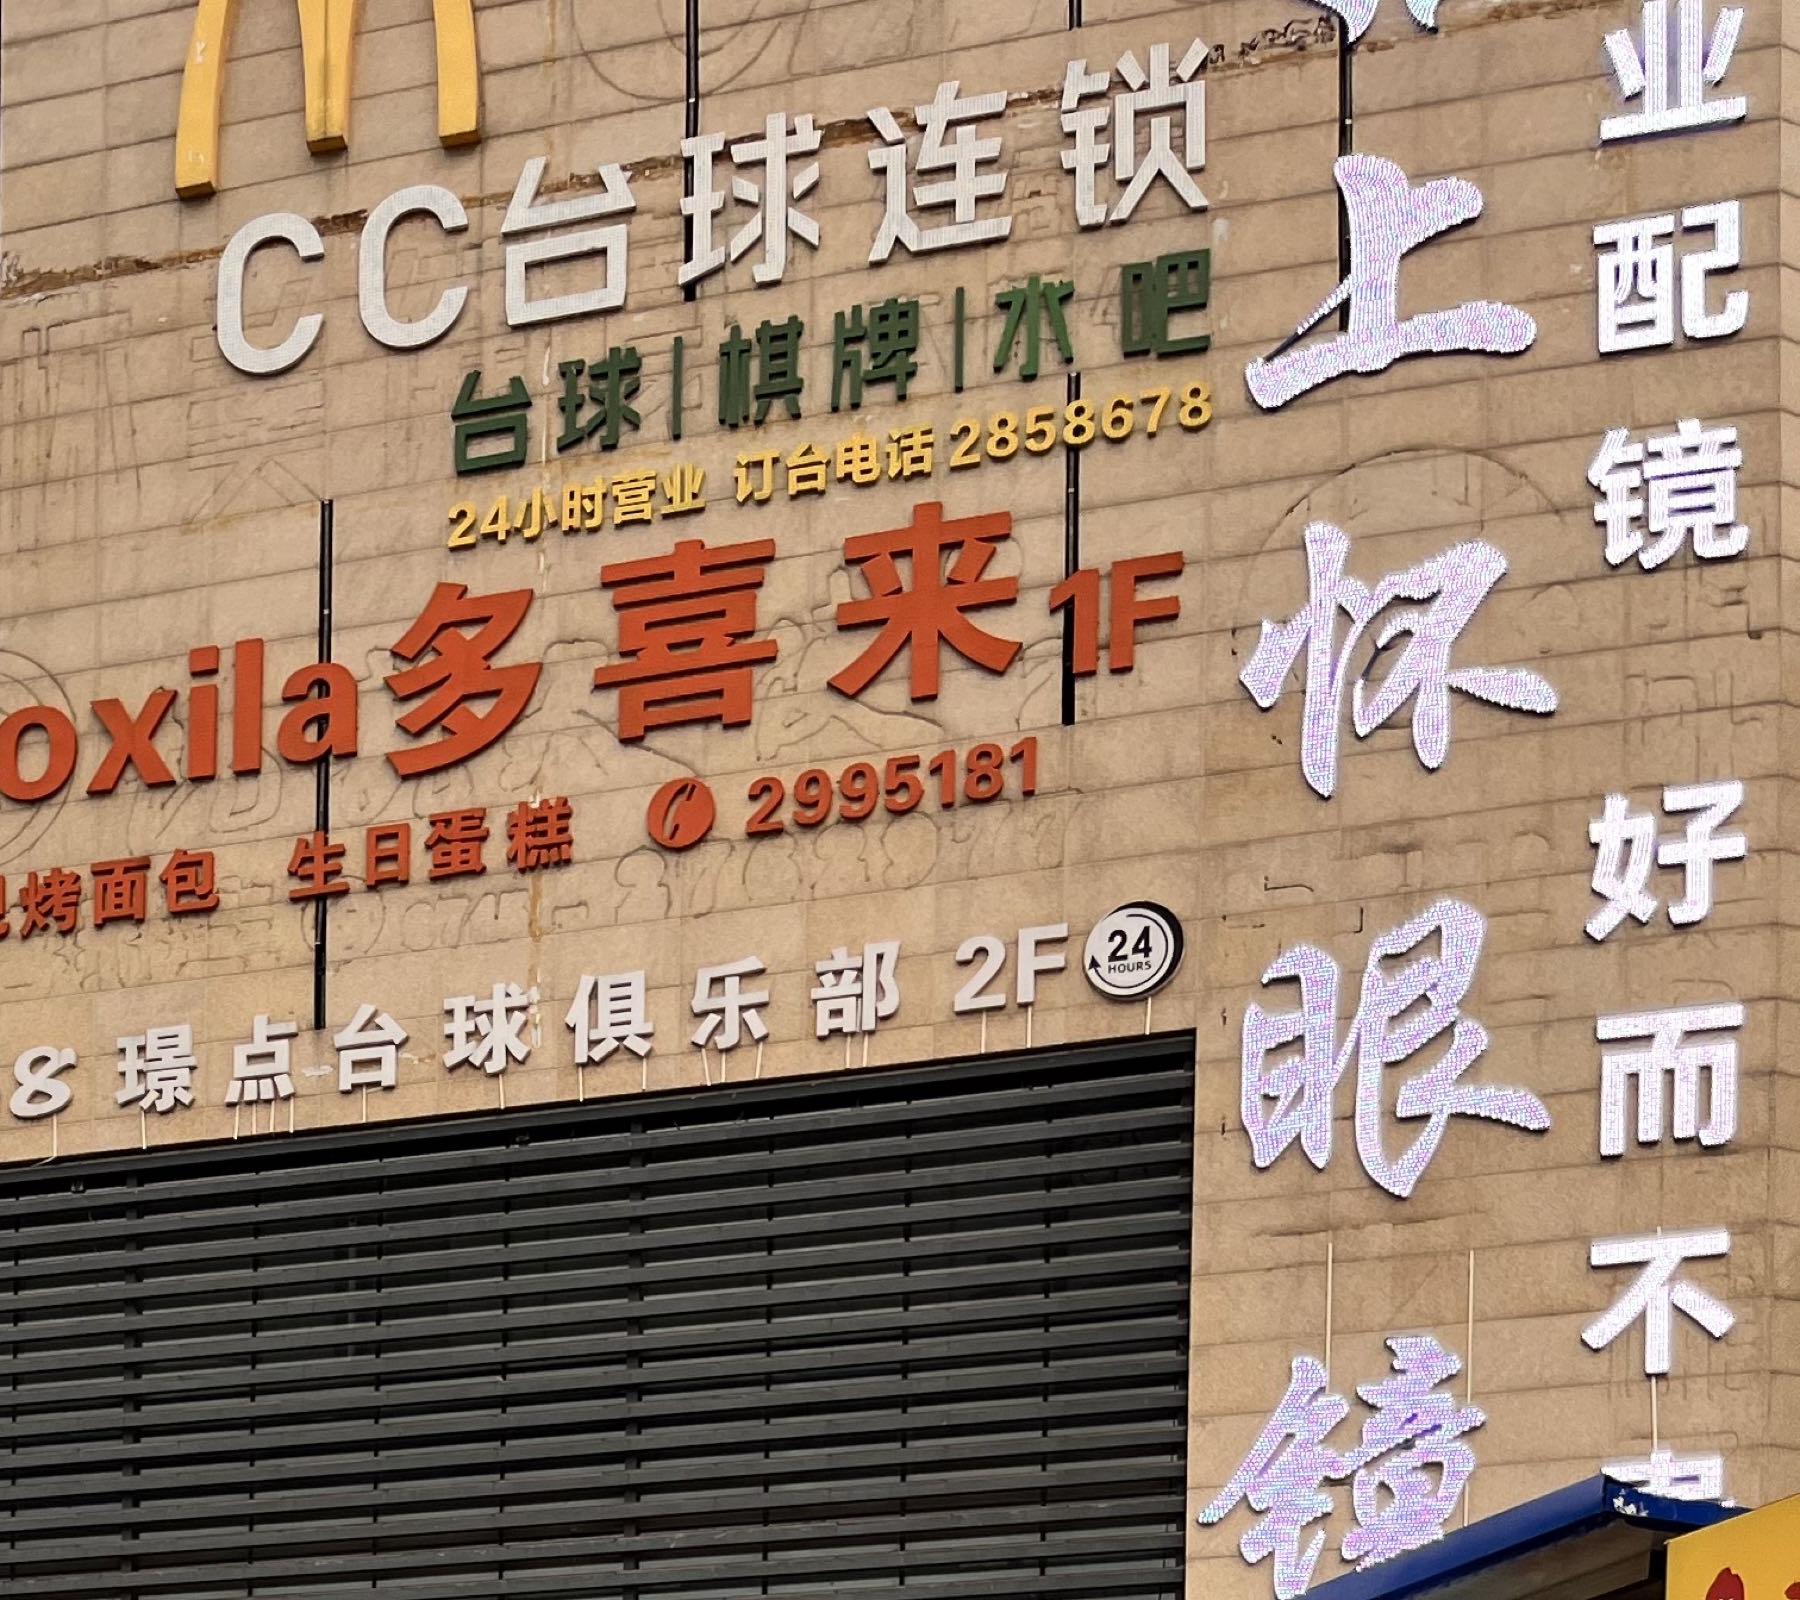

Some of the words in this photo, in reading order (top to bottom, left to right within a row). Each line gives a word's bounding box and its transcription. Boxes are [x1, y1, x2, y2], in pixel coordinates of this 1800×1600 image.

[216, 37, 1210, 374] CC台球连锁
[950, 380, 1214, 468] 2858678
[288, 796, 575, 902] 生日蛋糕
[746, 736, 1040, 835] 2995181
[1107, 925, 1154, 961] 24
[1107, 960, 1153, 974] HOURS
